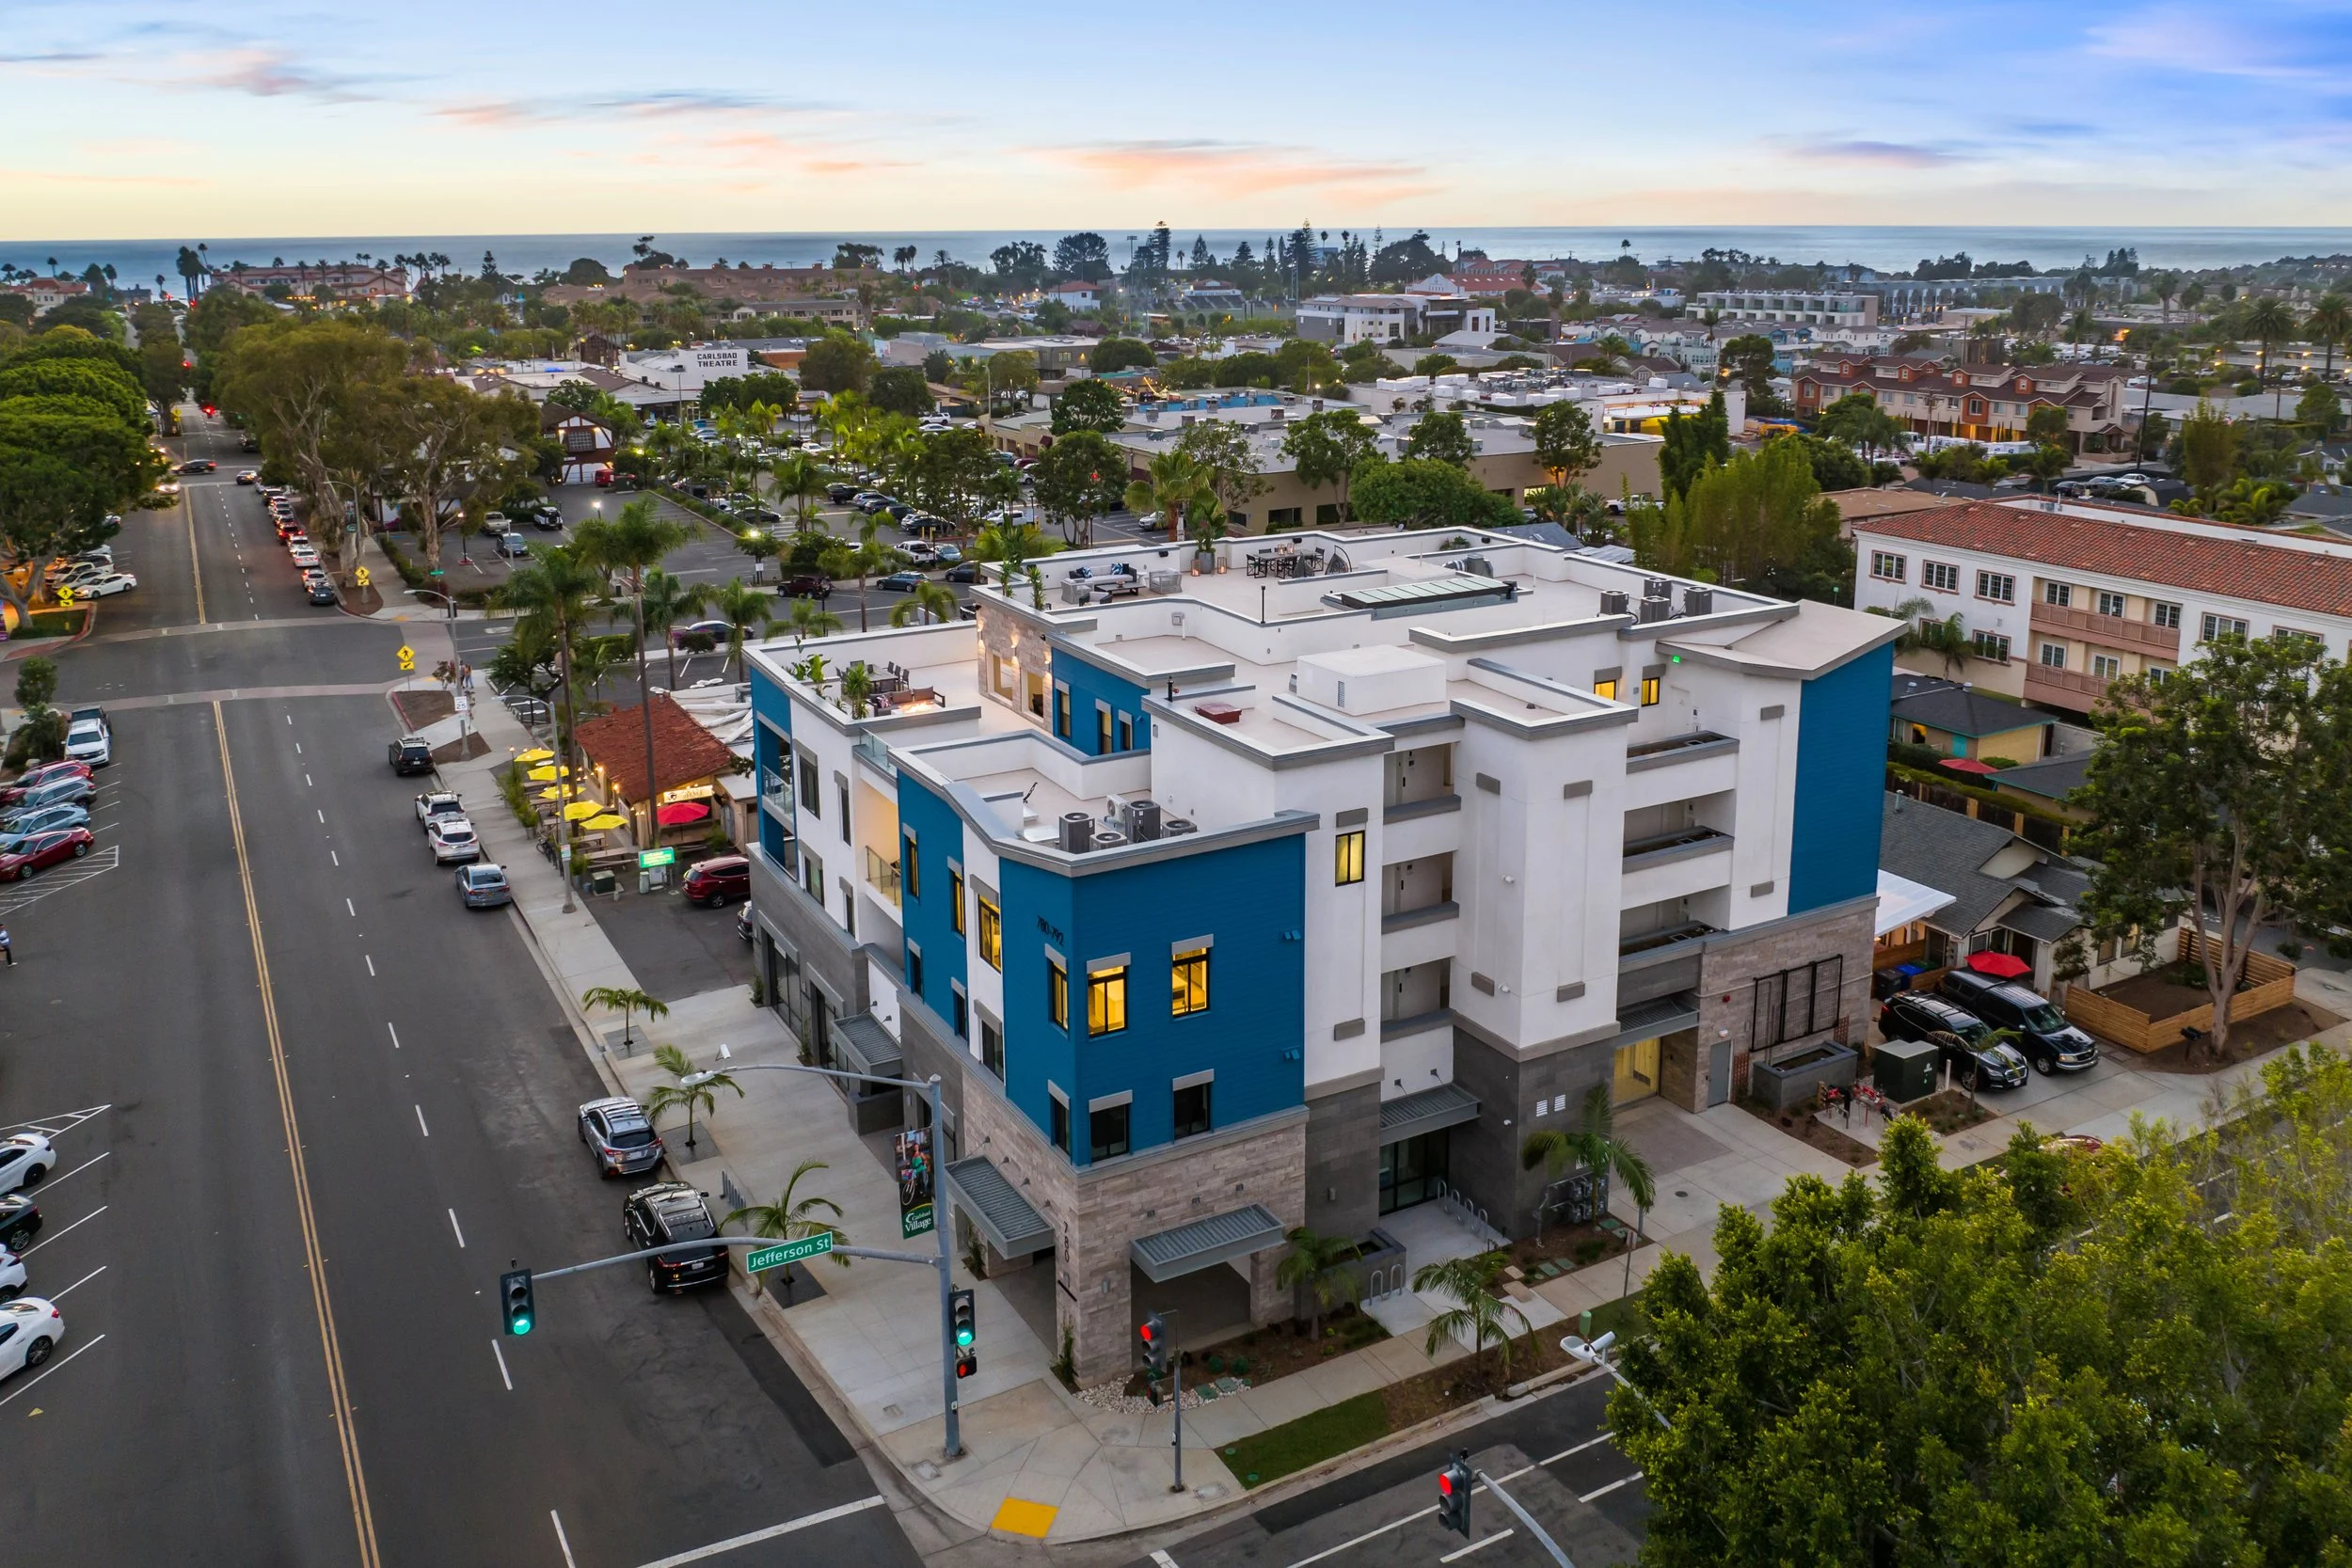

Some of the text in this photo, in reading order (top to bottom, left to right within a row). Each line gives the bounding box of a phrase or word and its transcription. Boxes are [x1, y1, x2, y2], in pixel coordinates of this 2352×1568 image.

[905, 1217, 931, 1232] Village
[751, 1238, 830, 1268] Jefferson St
